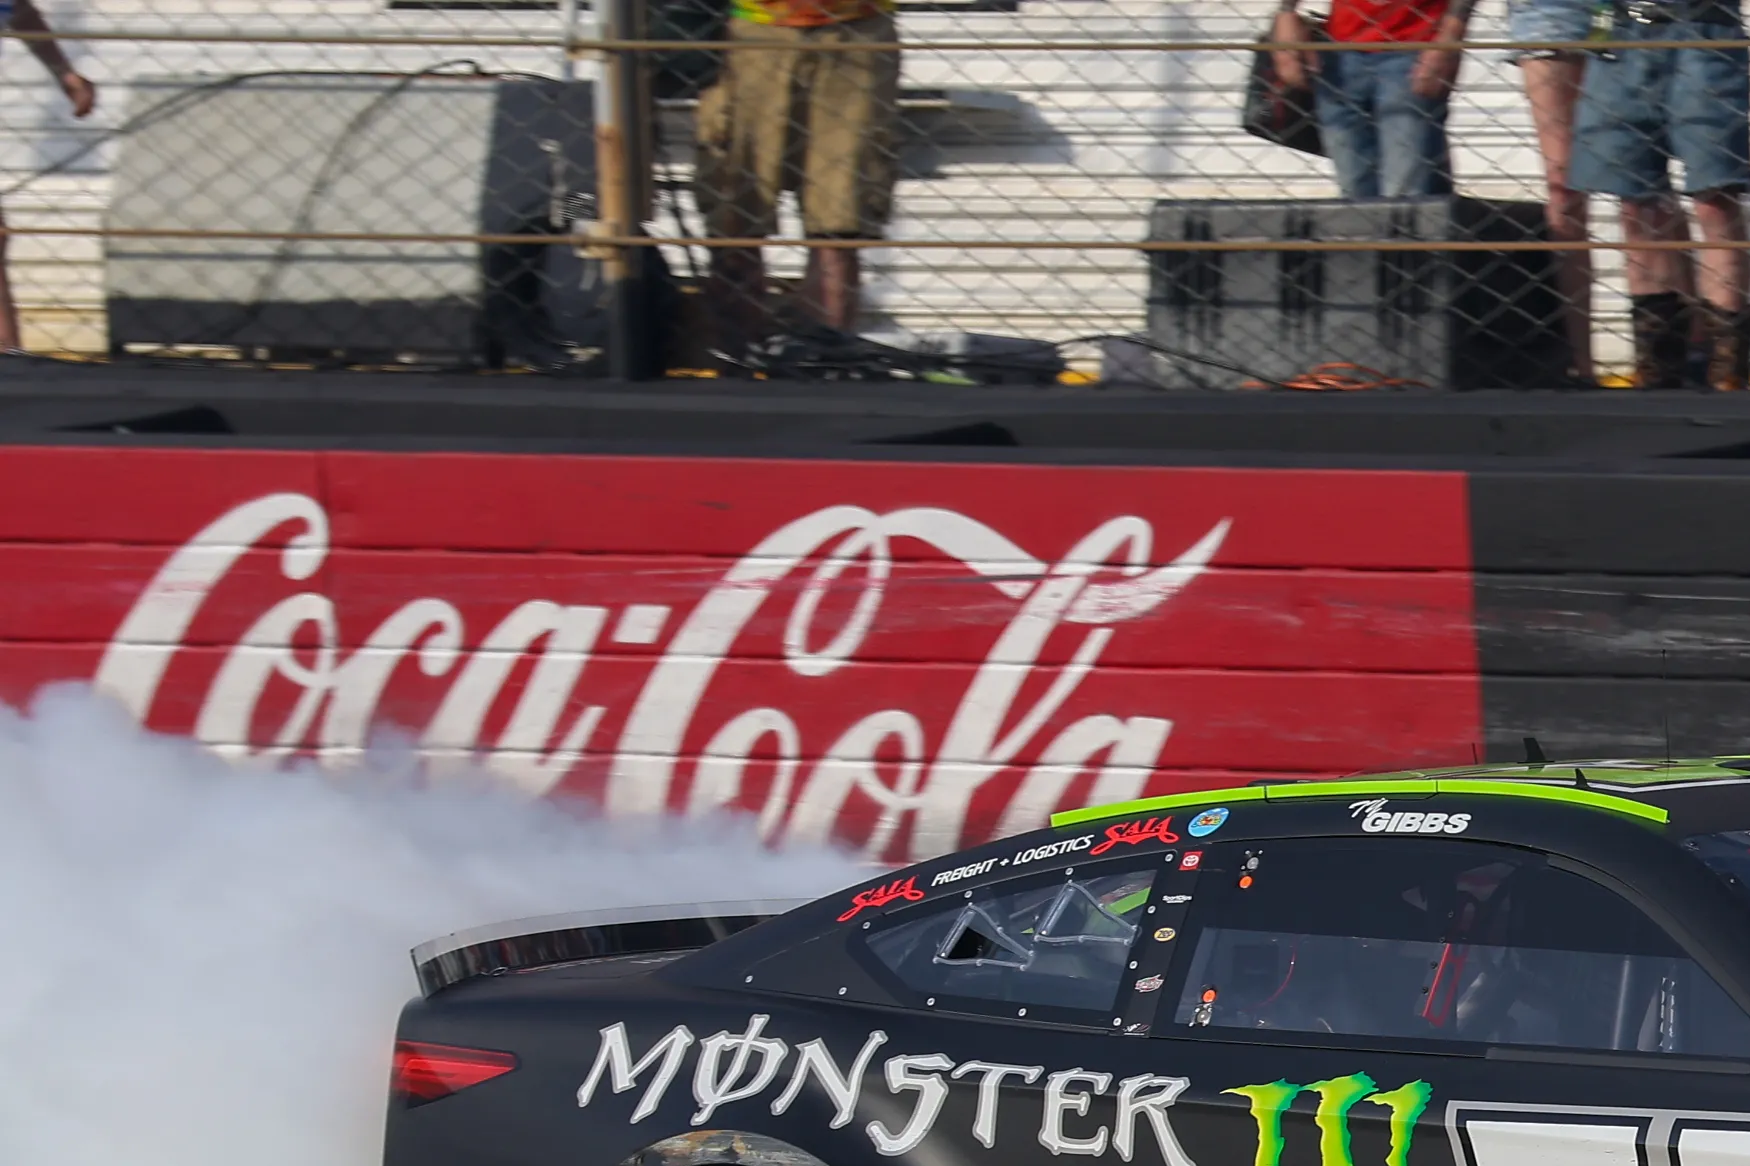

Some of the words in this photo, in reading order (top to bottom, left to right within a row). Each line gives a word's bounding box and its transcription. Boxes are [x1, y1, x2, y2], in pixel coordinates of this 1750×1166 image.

[1090, 815, 1180, 855] SAIA
[1362, 811, 1472, 834] GIBBS
[931, 857, 998, 887] FREIGHT
[1013, 834, 1095, 866] LOGISTICS
[837, 875, 924, 921] SAIA
